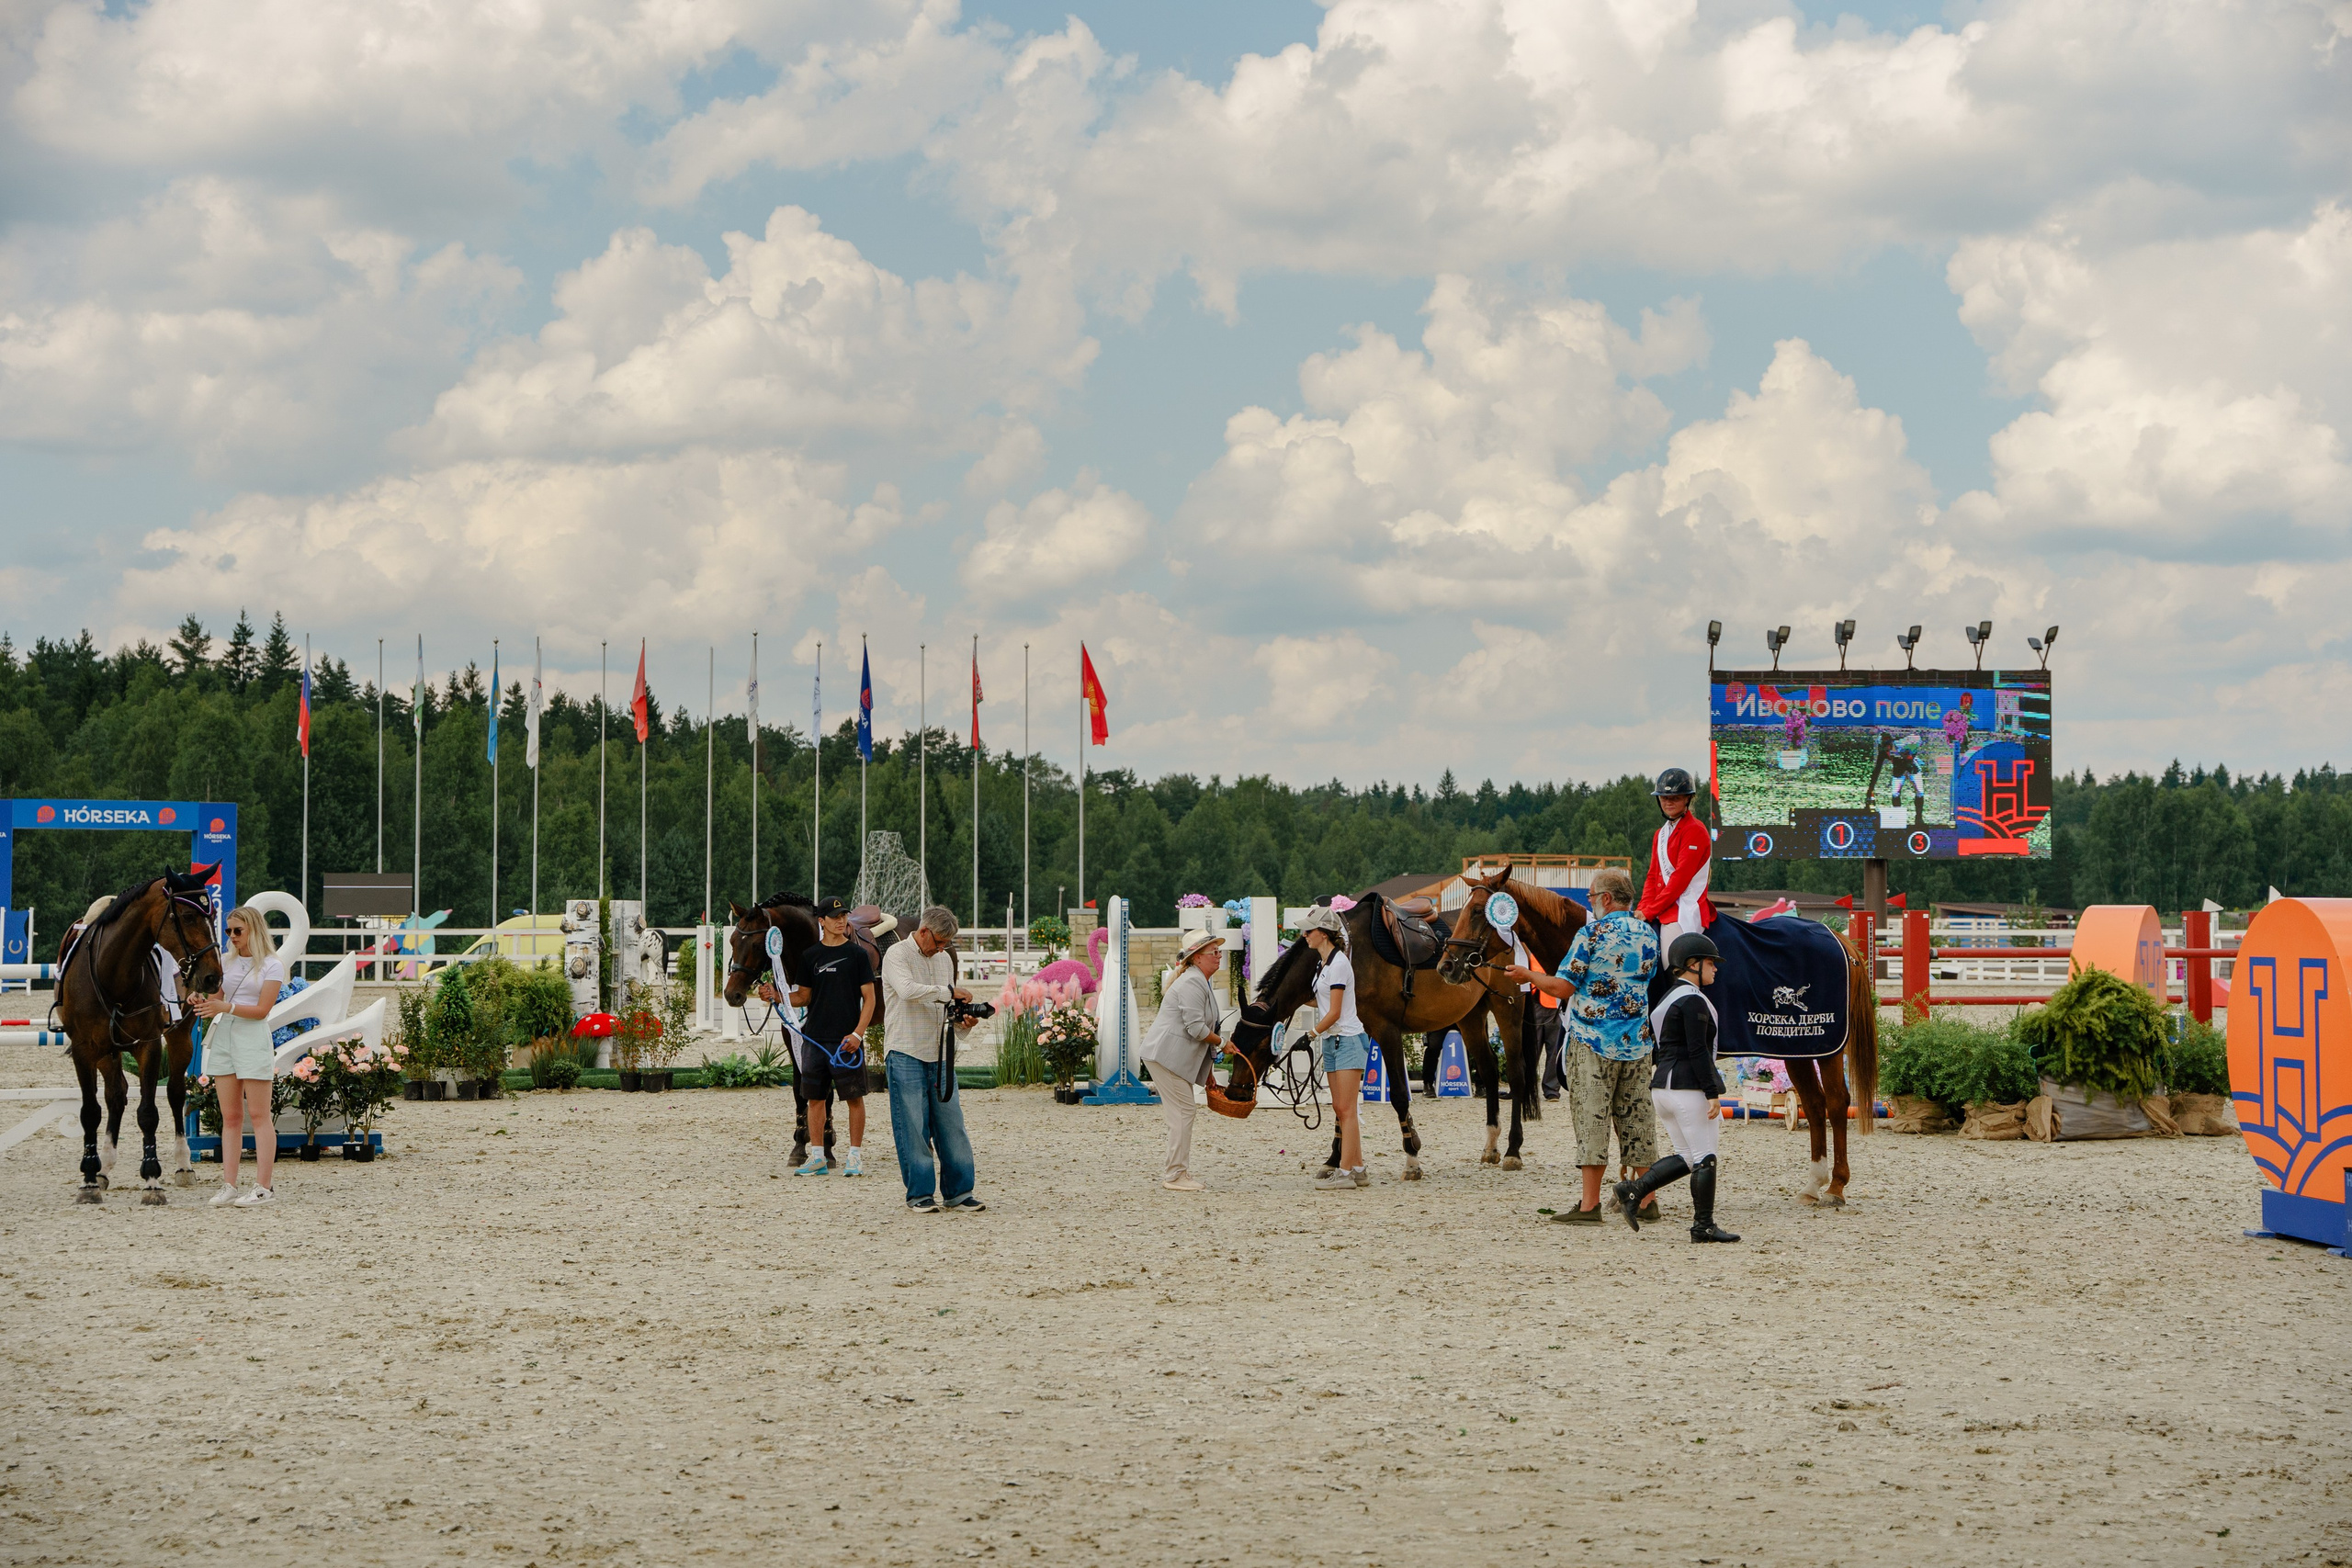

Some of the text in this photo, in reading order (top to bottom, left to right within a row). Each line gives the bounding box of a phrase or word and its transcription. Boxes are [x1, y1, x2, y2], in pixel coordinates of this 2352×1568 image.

[1875, 700, 1941, 719] поле
[63, 805, 151, 824] HÓRSEKA
[1835, 825, 1845, 845] 1
[1914, 835, 1925, 850] 3
[1756, 837, 1767, 852] 2
[1747, 1012, 1835, 1025] ХОРСЕКА ДЕРБИ
[1756, 1025, 1825, 1037] ПОБЕДИТЕЛЬ
[1371, 1046, 1379, 1061] 5
[1448, 1042, 1456, 1057] 1
